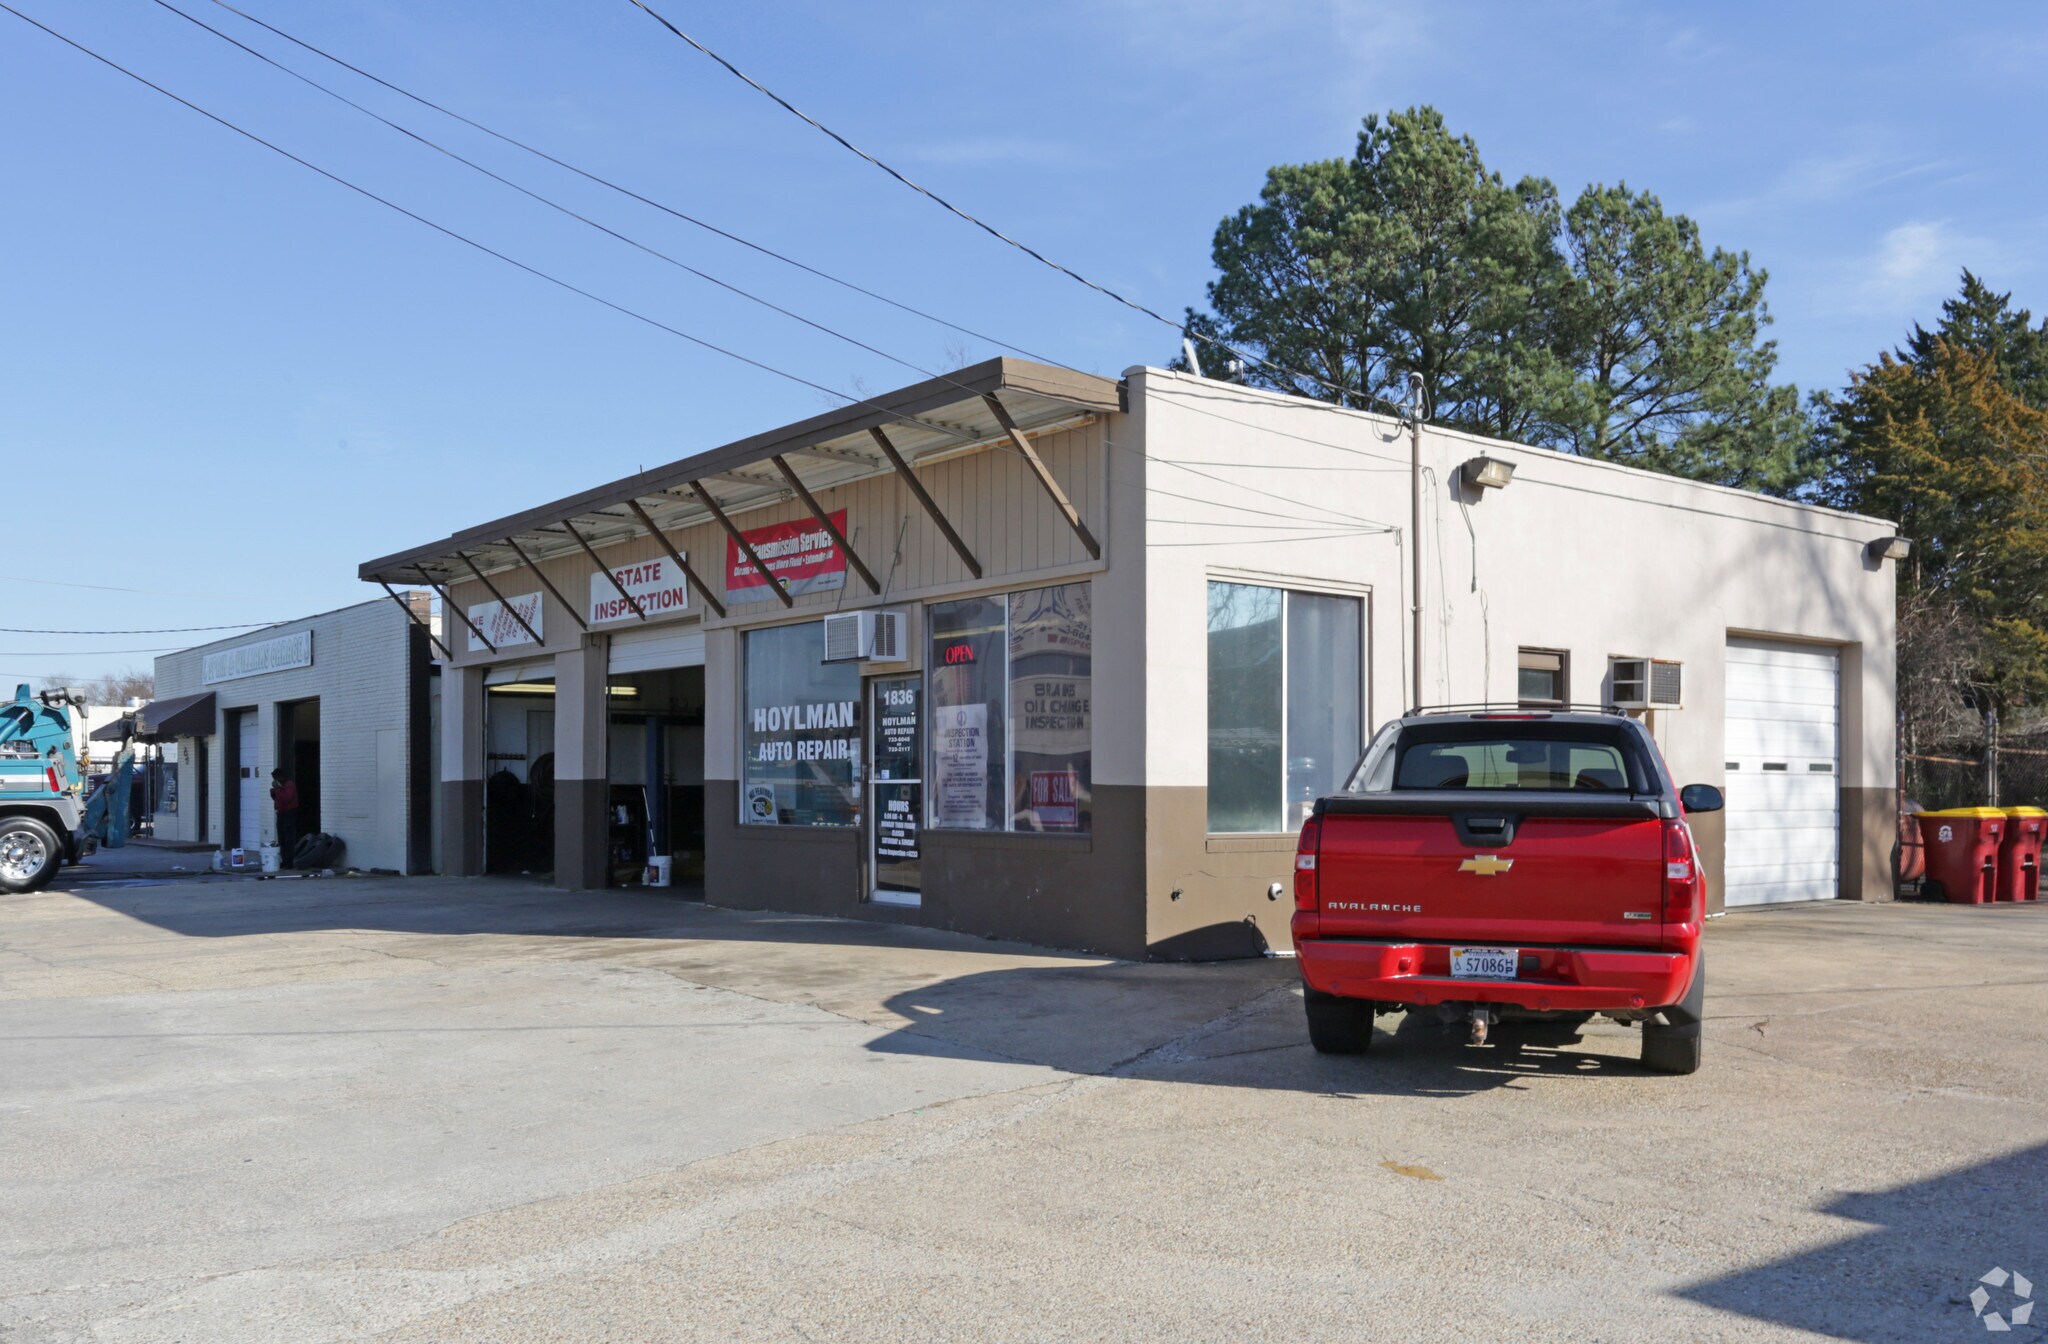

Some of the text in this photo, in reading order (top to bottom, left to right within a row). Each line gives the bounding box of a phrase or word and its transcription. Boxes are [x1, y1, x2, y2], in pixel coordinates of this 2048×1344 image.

[749, 536, 800, 561] ransmission
[615, 562, 662, 587] STATE
[594, 587, 684, 621] INSPECTION
[471, 616, 484, 626] WE
[271, 637, 303, 668] GARAGE
[945, 644, 974, 664] OPEN
[884, 689, 914, 706] 1836
[753, 701, 854, 732] HOYLMAN
[882, 716, 916, 726] HOYLMAN
[944, 728, 980, 738] INSPECTION
[759, 738, 849, 762] AUTO REPAIR
[948, 738, 976, 748] STATION
[1033, 776, 1076, 802] FOR SAL
[888, 800, 909, 812] HOURS
[1328, 902, 1422, 913] AVALANCHE
[1466, 957, 1505, 973] 57086
